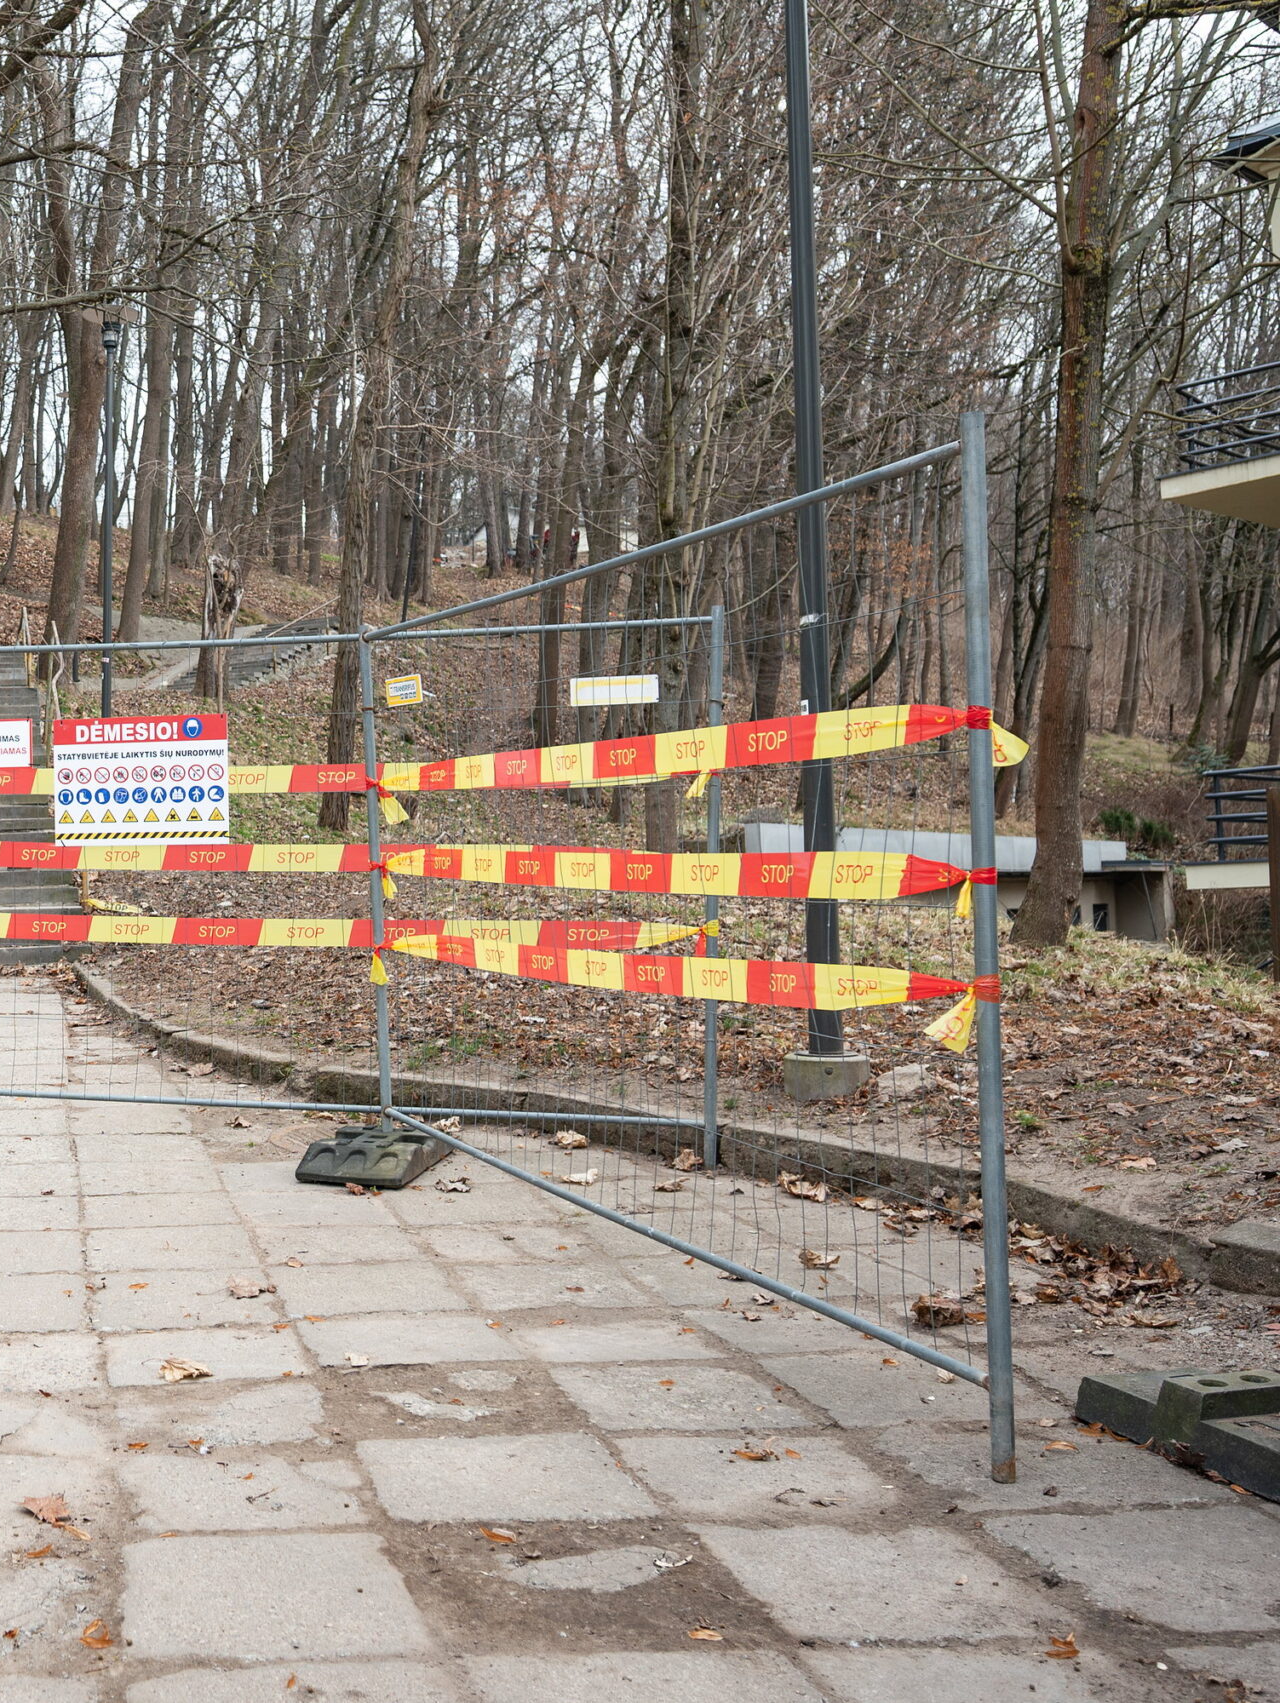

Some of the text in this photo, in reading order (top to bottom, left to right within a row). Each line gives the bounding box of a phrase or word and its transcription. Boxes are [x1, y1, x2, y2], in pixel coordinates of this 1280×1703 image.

[75, 720, 178, 743] DĖMESIO!
[57, 748, 225, 761] STATYBVIETĖJE LAIKYTIS ŠIŲ NURODYMŲ!
[465, 764, 482, 780] STOP
[506, 760, 527, 775] STOP
[556, 755, 578, 771] STOP
[610, 749, 637, 766] STOP
[676, 740, 705, 759] STOP
[748, 730, 787, 752] STOP
[228, 774, 265, 785] STOP
[317, 771, 356, 783] STOP
[21, 849, 56, 861] STOP
[104, 850, 140, 863] STOP
[189, 851, 226, 863] STOP
[276, 852, 315, 864] STOP
[434, 856, 873, 883] STOP STOP STOP STOP STOP STOP STOP STOP
[104, 903, 129, 911] STOP
[32, 921, 67, 933] STOP
[114, 924, 149, 935] STOP
[198, 926, 236, 938] STOP
[287, 926, 325, 939] STOP
[471, 929, 510, 940] STOP
[567, 928, 609, 941] STOP
[485, 949, 505, 963] STOP
[532, 955, 554, 970] STOP
[585, 961, 607, 976] STOP
[638, 966, 666, 982] STOP
[701, 970, 728, 987] STOP
[770, 973, 796, 993] STOP
[838, 978, 877, 996] STOP
